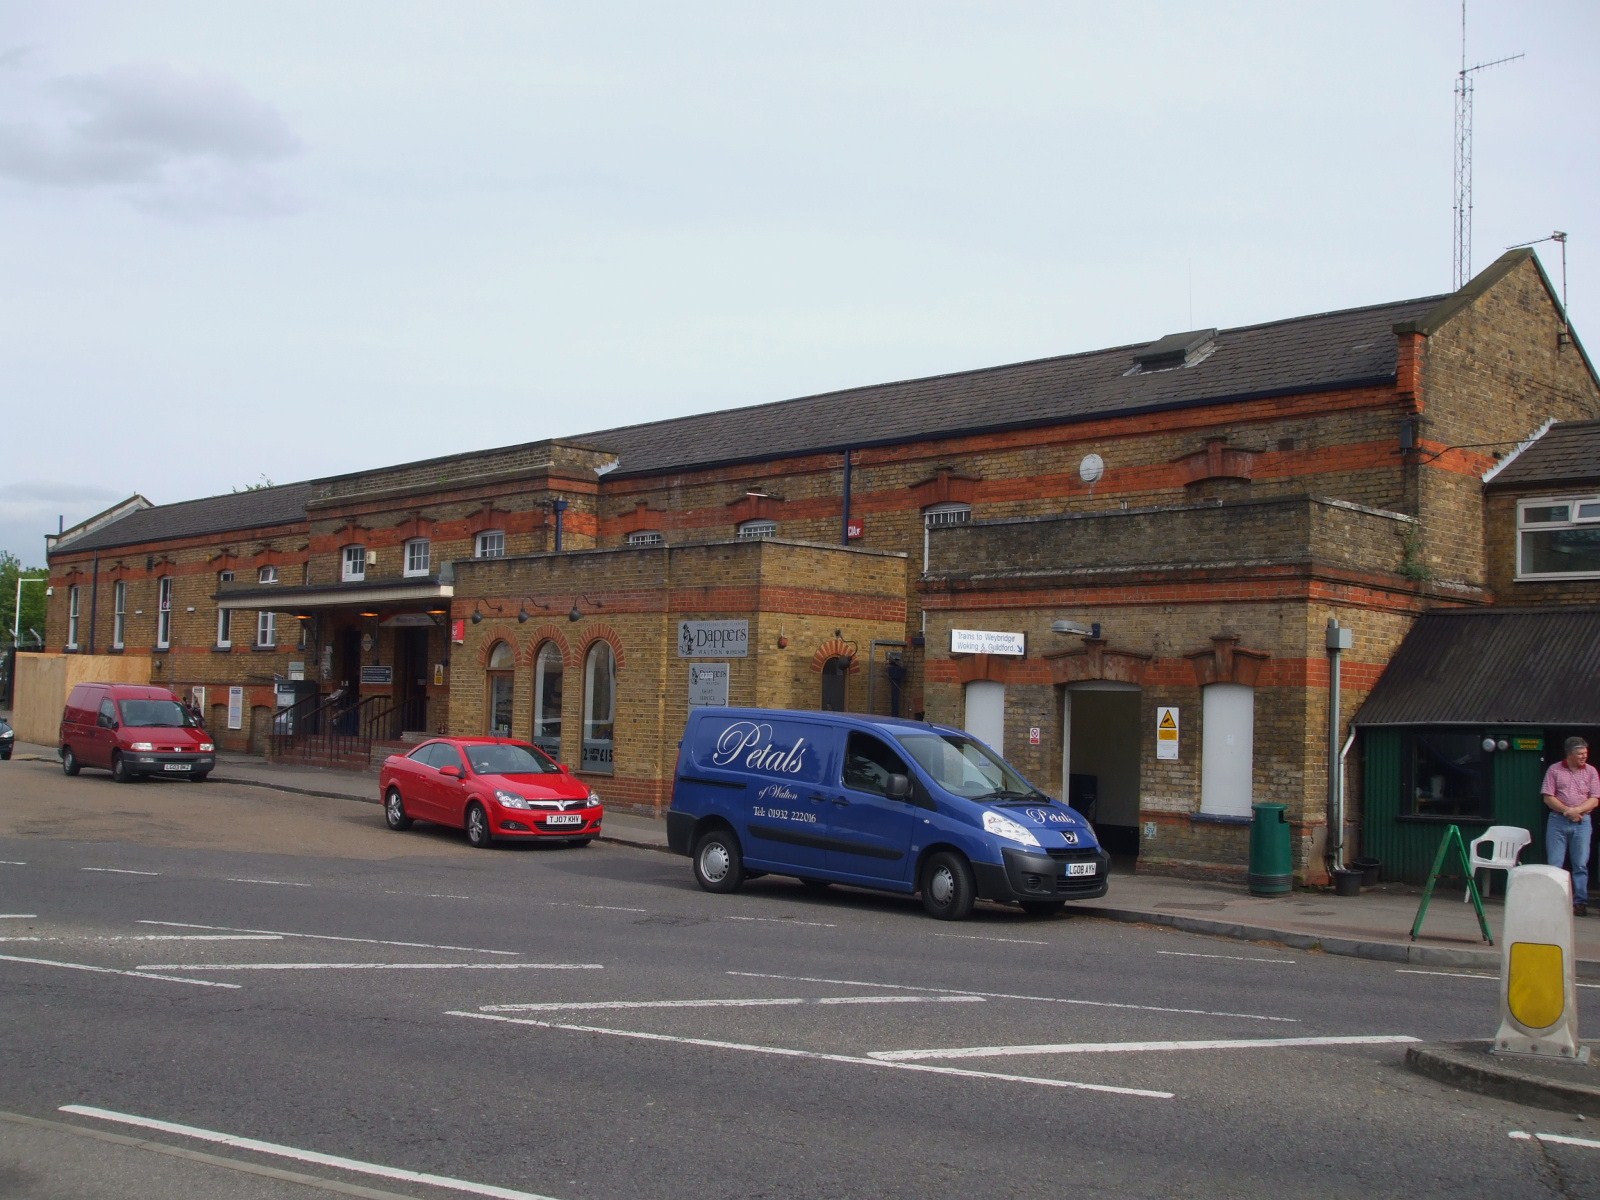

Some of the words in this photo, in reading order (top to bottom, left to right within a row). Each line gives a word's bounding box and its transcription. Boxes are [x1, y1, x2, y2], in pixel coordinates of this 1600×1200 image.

[696, 628, 747, 648] Dappers
[958, 632, 975, 640] Trains
[977, 633, 983, 641] to
[985, 633, 1016, 643] Weybridge
[957, 642, 979, 651] Woking
[713, 721, 806, 773] Petals
[600, 749, 613, 762] £15
[758, 786, 768, 800] of
[768, 784, 798, 800] Walton
[550, 815, 567, 823] TJ07
[768, 808, 788, 820] 01932
[791, 811, 816, 823] 222016
[1025, 808, 1075, 824] Petals
[1069, 866, 1085, 875] LG08
